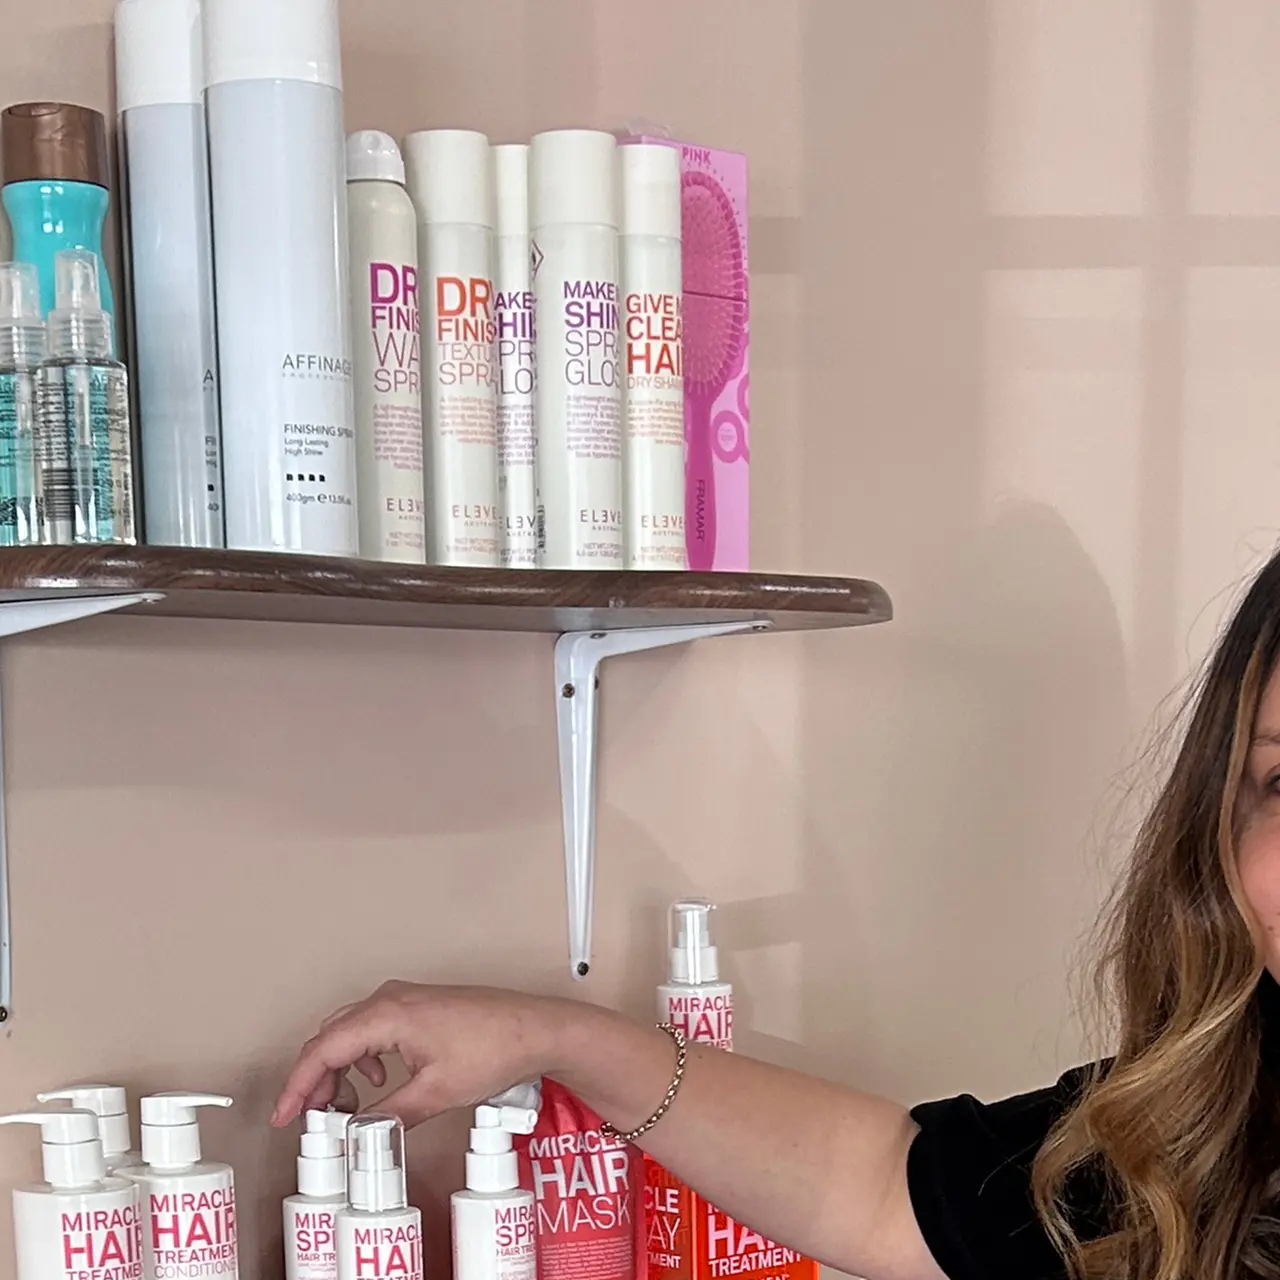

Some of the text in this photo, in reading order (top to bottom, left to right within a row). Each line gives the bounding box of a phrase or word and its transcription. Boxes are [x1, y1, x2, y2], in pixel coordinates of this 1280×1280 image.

[682, 147, 711, 165] PINK
[370, 262, 420, 309] DR
[494, 291, 533, 310] AKE
[564, 301, 621, 331] SHIN
[625, 316, 684, 341] CLEA
[437, 318, 496, 345] FINIS
[564, 330, 621, 359] SPR
[372, 331, 421, 369] WA
[374, 368, 421, 395] SPR
[531, 1150, 630, 1200] HAIR
[644, 1185, 680, 1214] CLE
[61, 1202, 142, 1232] MIRACL
[295, 1212, 335, 1229] MIR
[536, 1192, 631, 1236] MASK
[354, 1224, 420, 1246] MIRACL
[646, 1215, 681, 1250] AY
[152, 1241, 237, 1265] TREATMEN
[322, 1252, 336, 1262] TR
